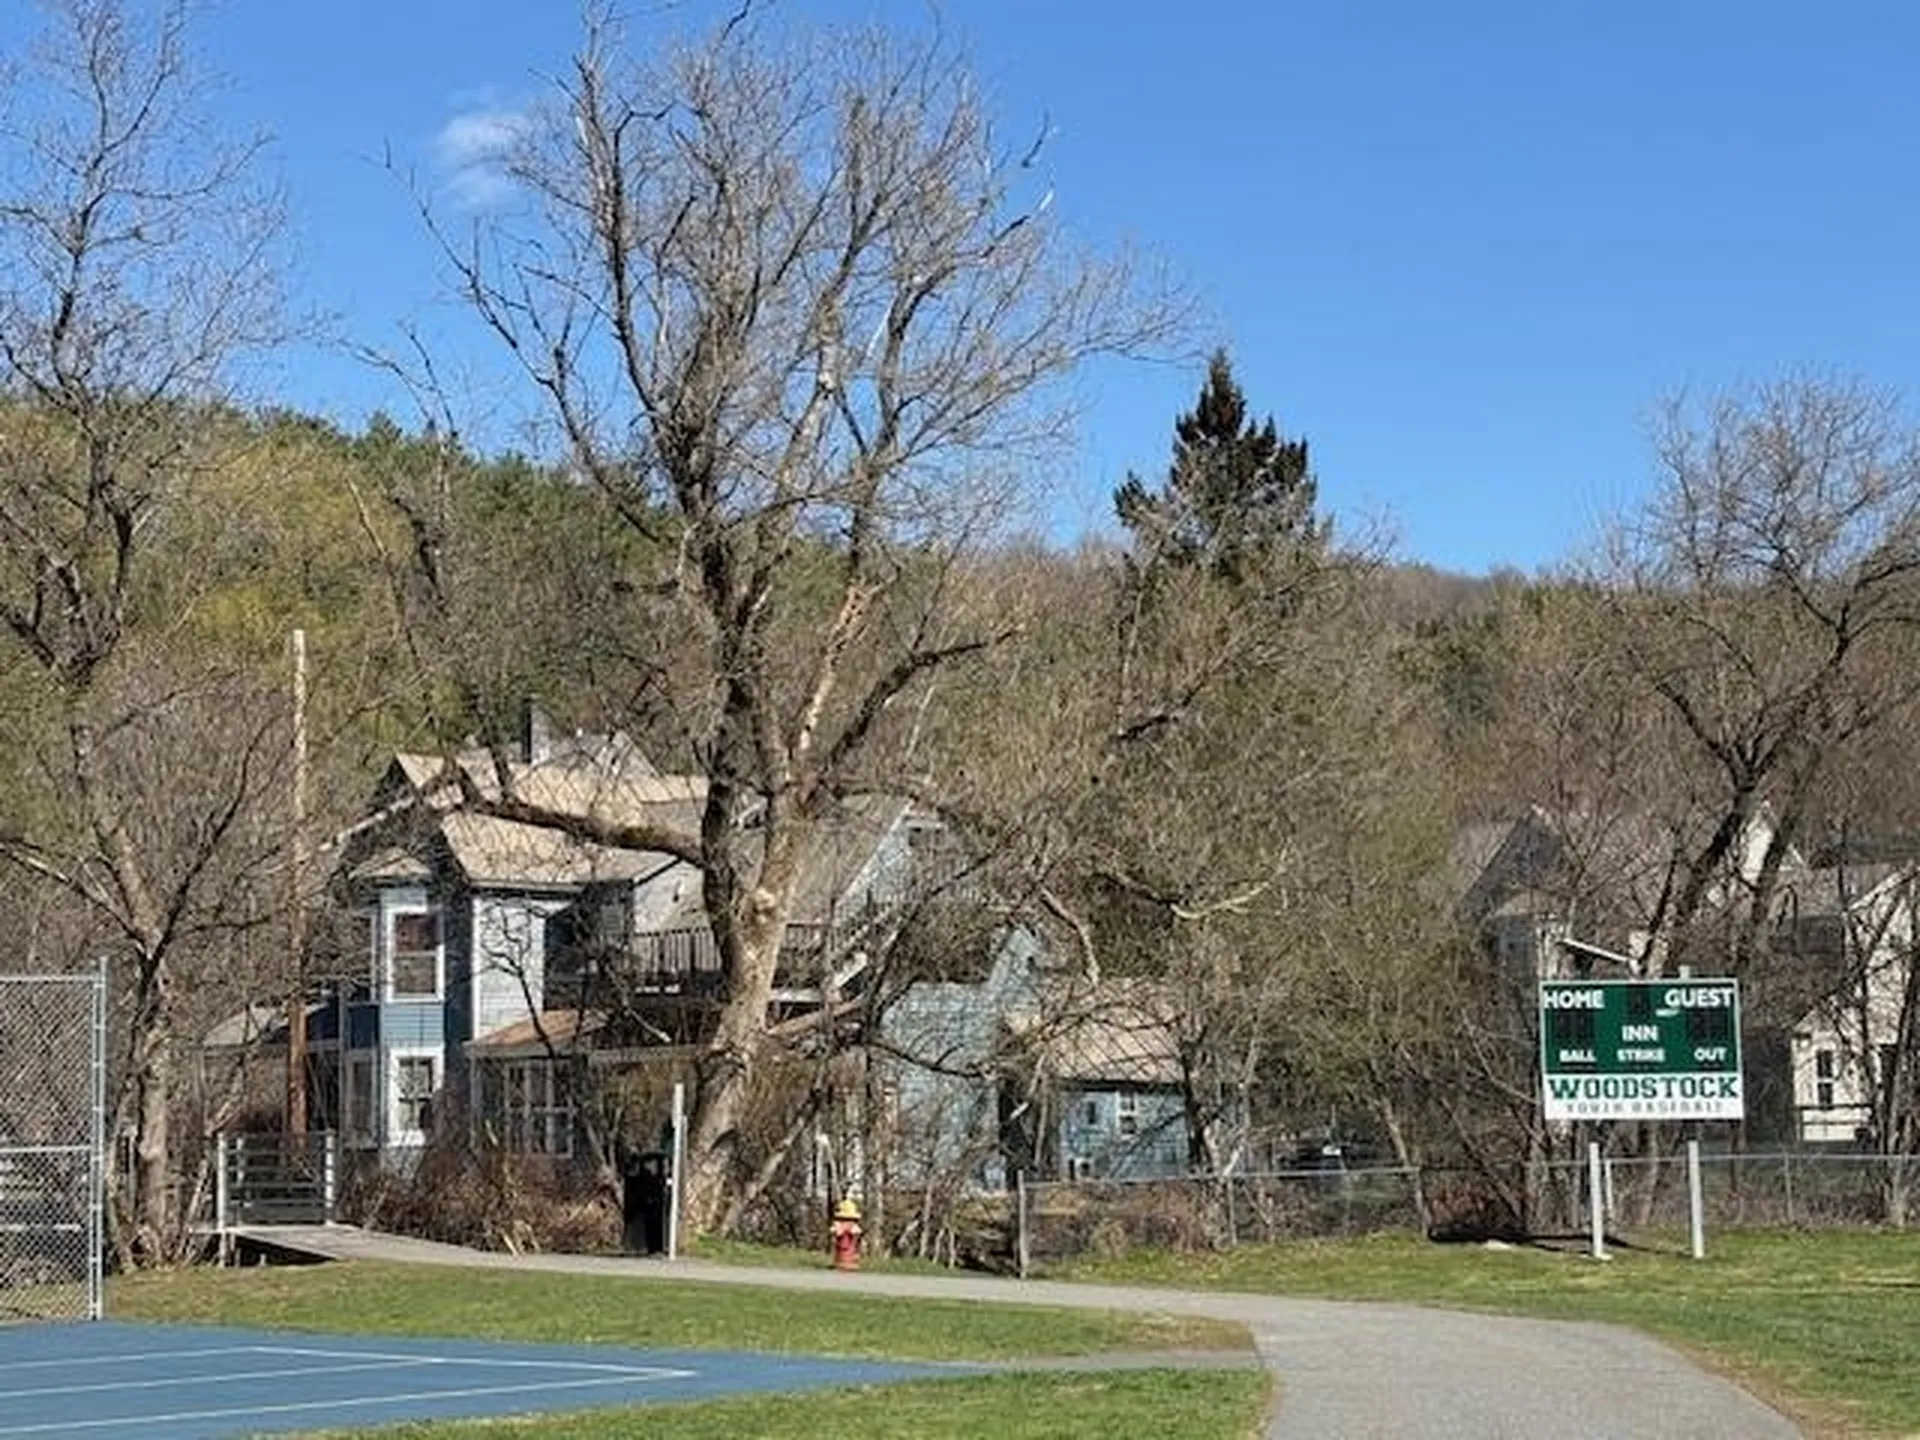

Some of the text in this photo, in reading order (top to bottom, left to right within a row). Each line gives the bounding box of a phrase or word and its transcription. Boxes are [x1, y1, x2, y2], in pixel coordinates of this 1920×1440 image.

[1544, 988, 1734, 1008] HOME GUEST
[1622, 1025, 1659, 1041] INN
[1559, 1047, 1727, 1062] BALL STRIKE OUT
[1549, 1076, 1738, 1099] WOODSTOCK
